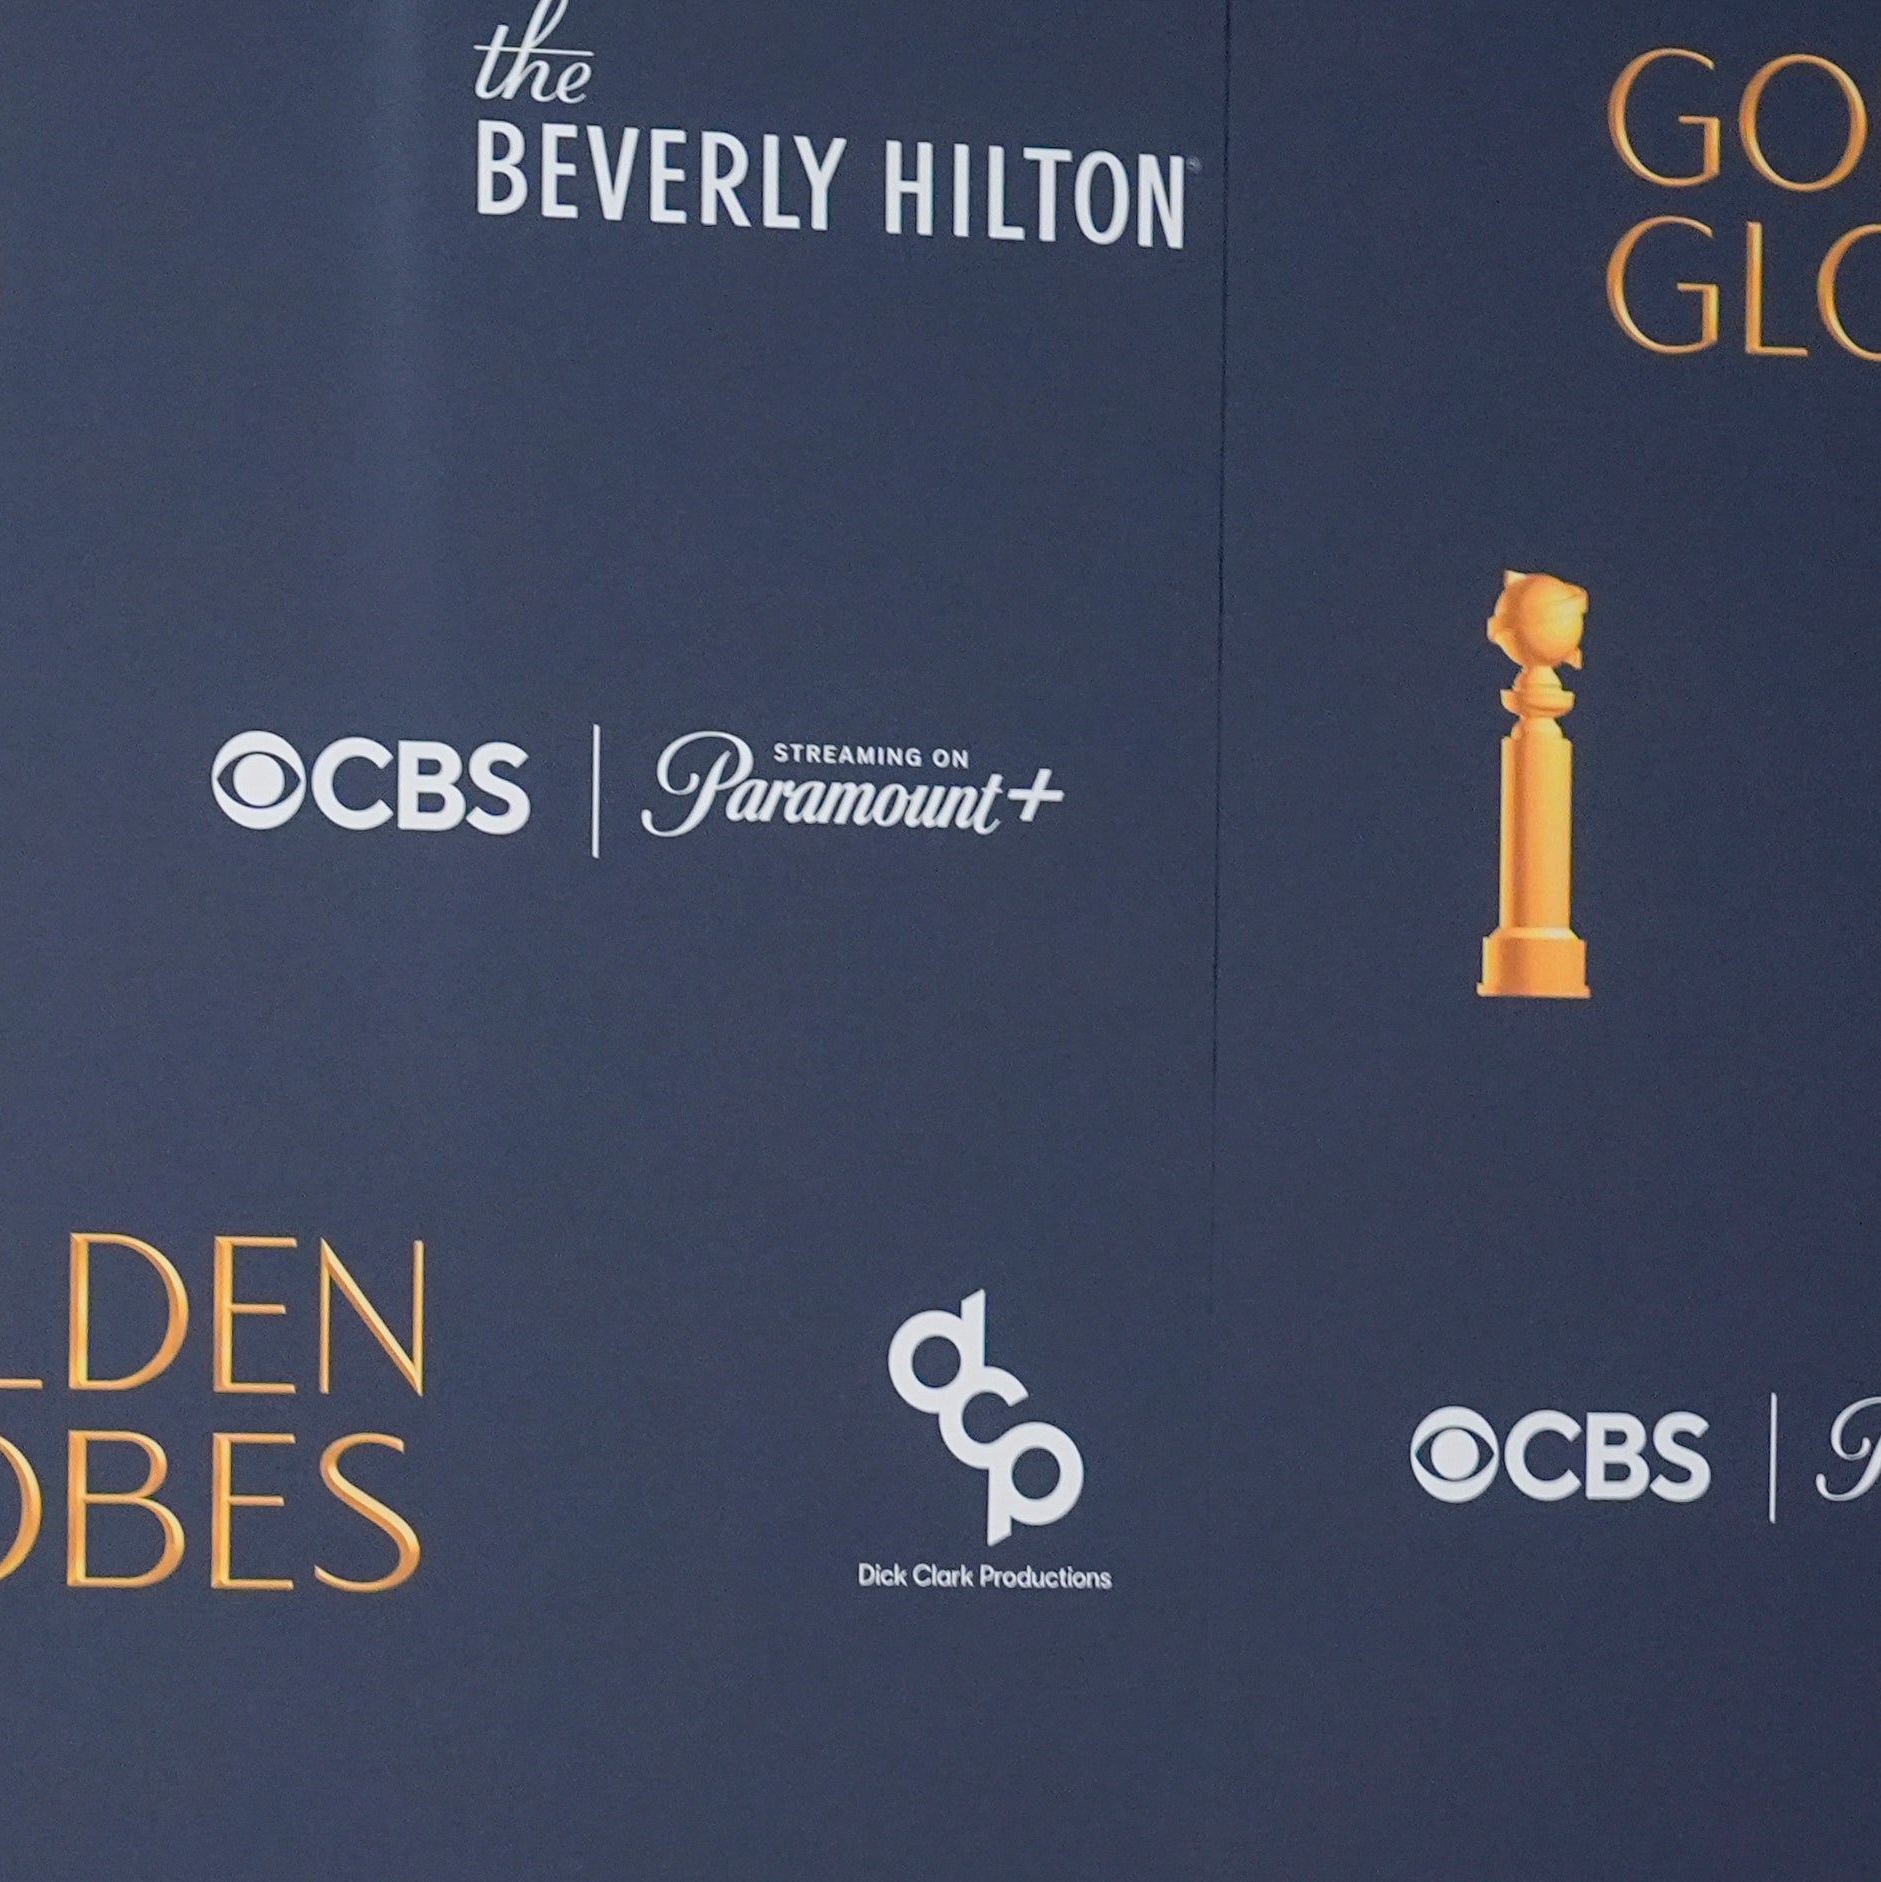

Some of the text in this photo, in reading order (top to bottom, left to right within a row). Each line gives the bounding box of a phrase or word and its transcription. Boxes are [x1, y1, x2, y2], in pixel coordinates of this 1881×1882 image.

[474, 0, 594, 104] the
[477, 119, 848, 231] BEVERLY
[311, 736, 531, 836] CBS
[774, 742, 969, 769] STREAMING ON
[1505, 1409, 1712, 1503] CBS
[858, 1562, 1113, 1590] Dick Clark Productions
